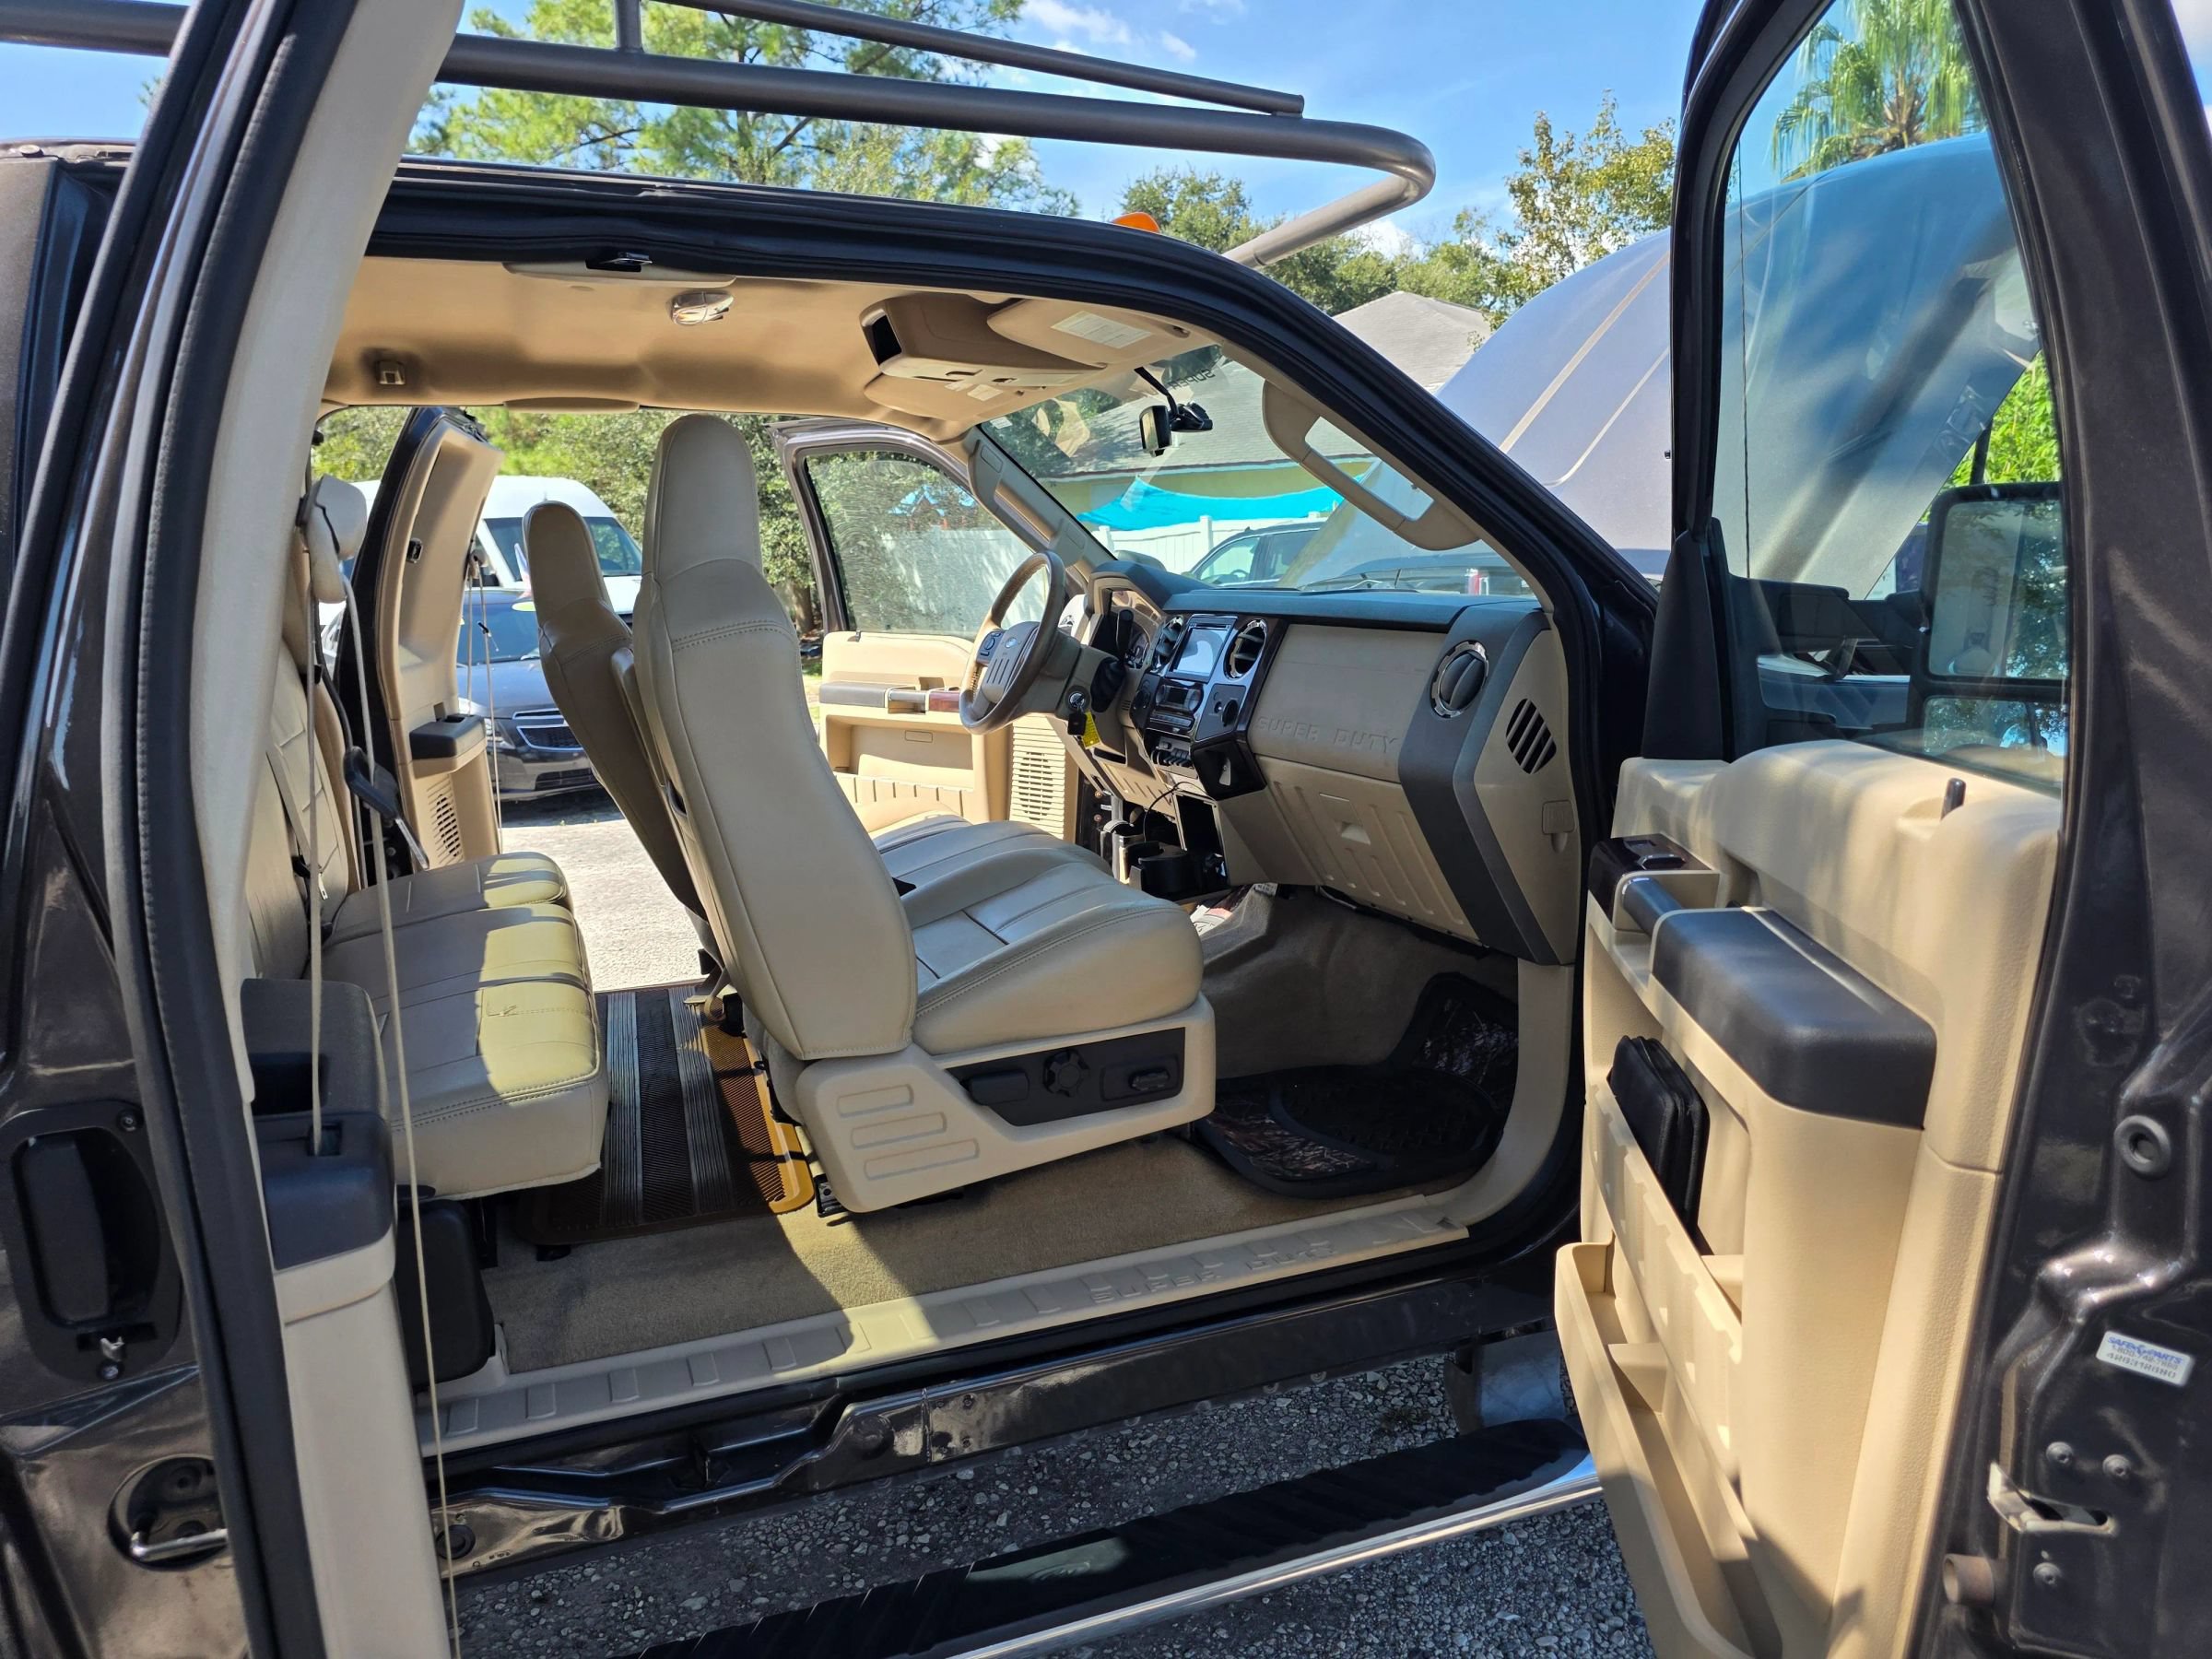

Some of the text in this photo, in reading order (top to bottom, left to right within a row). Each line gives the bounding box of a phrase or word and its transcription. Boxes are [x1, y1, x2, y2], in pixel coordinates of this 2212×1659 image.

[1256, 715, 1398, 753] SUPER DUTY
[1090, 1269, 1222, 1304] SUPER
